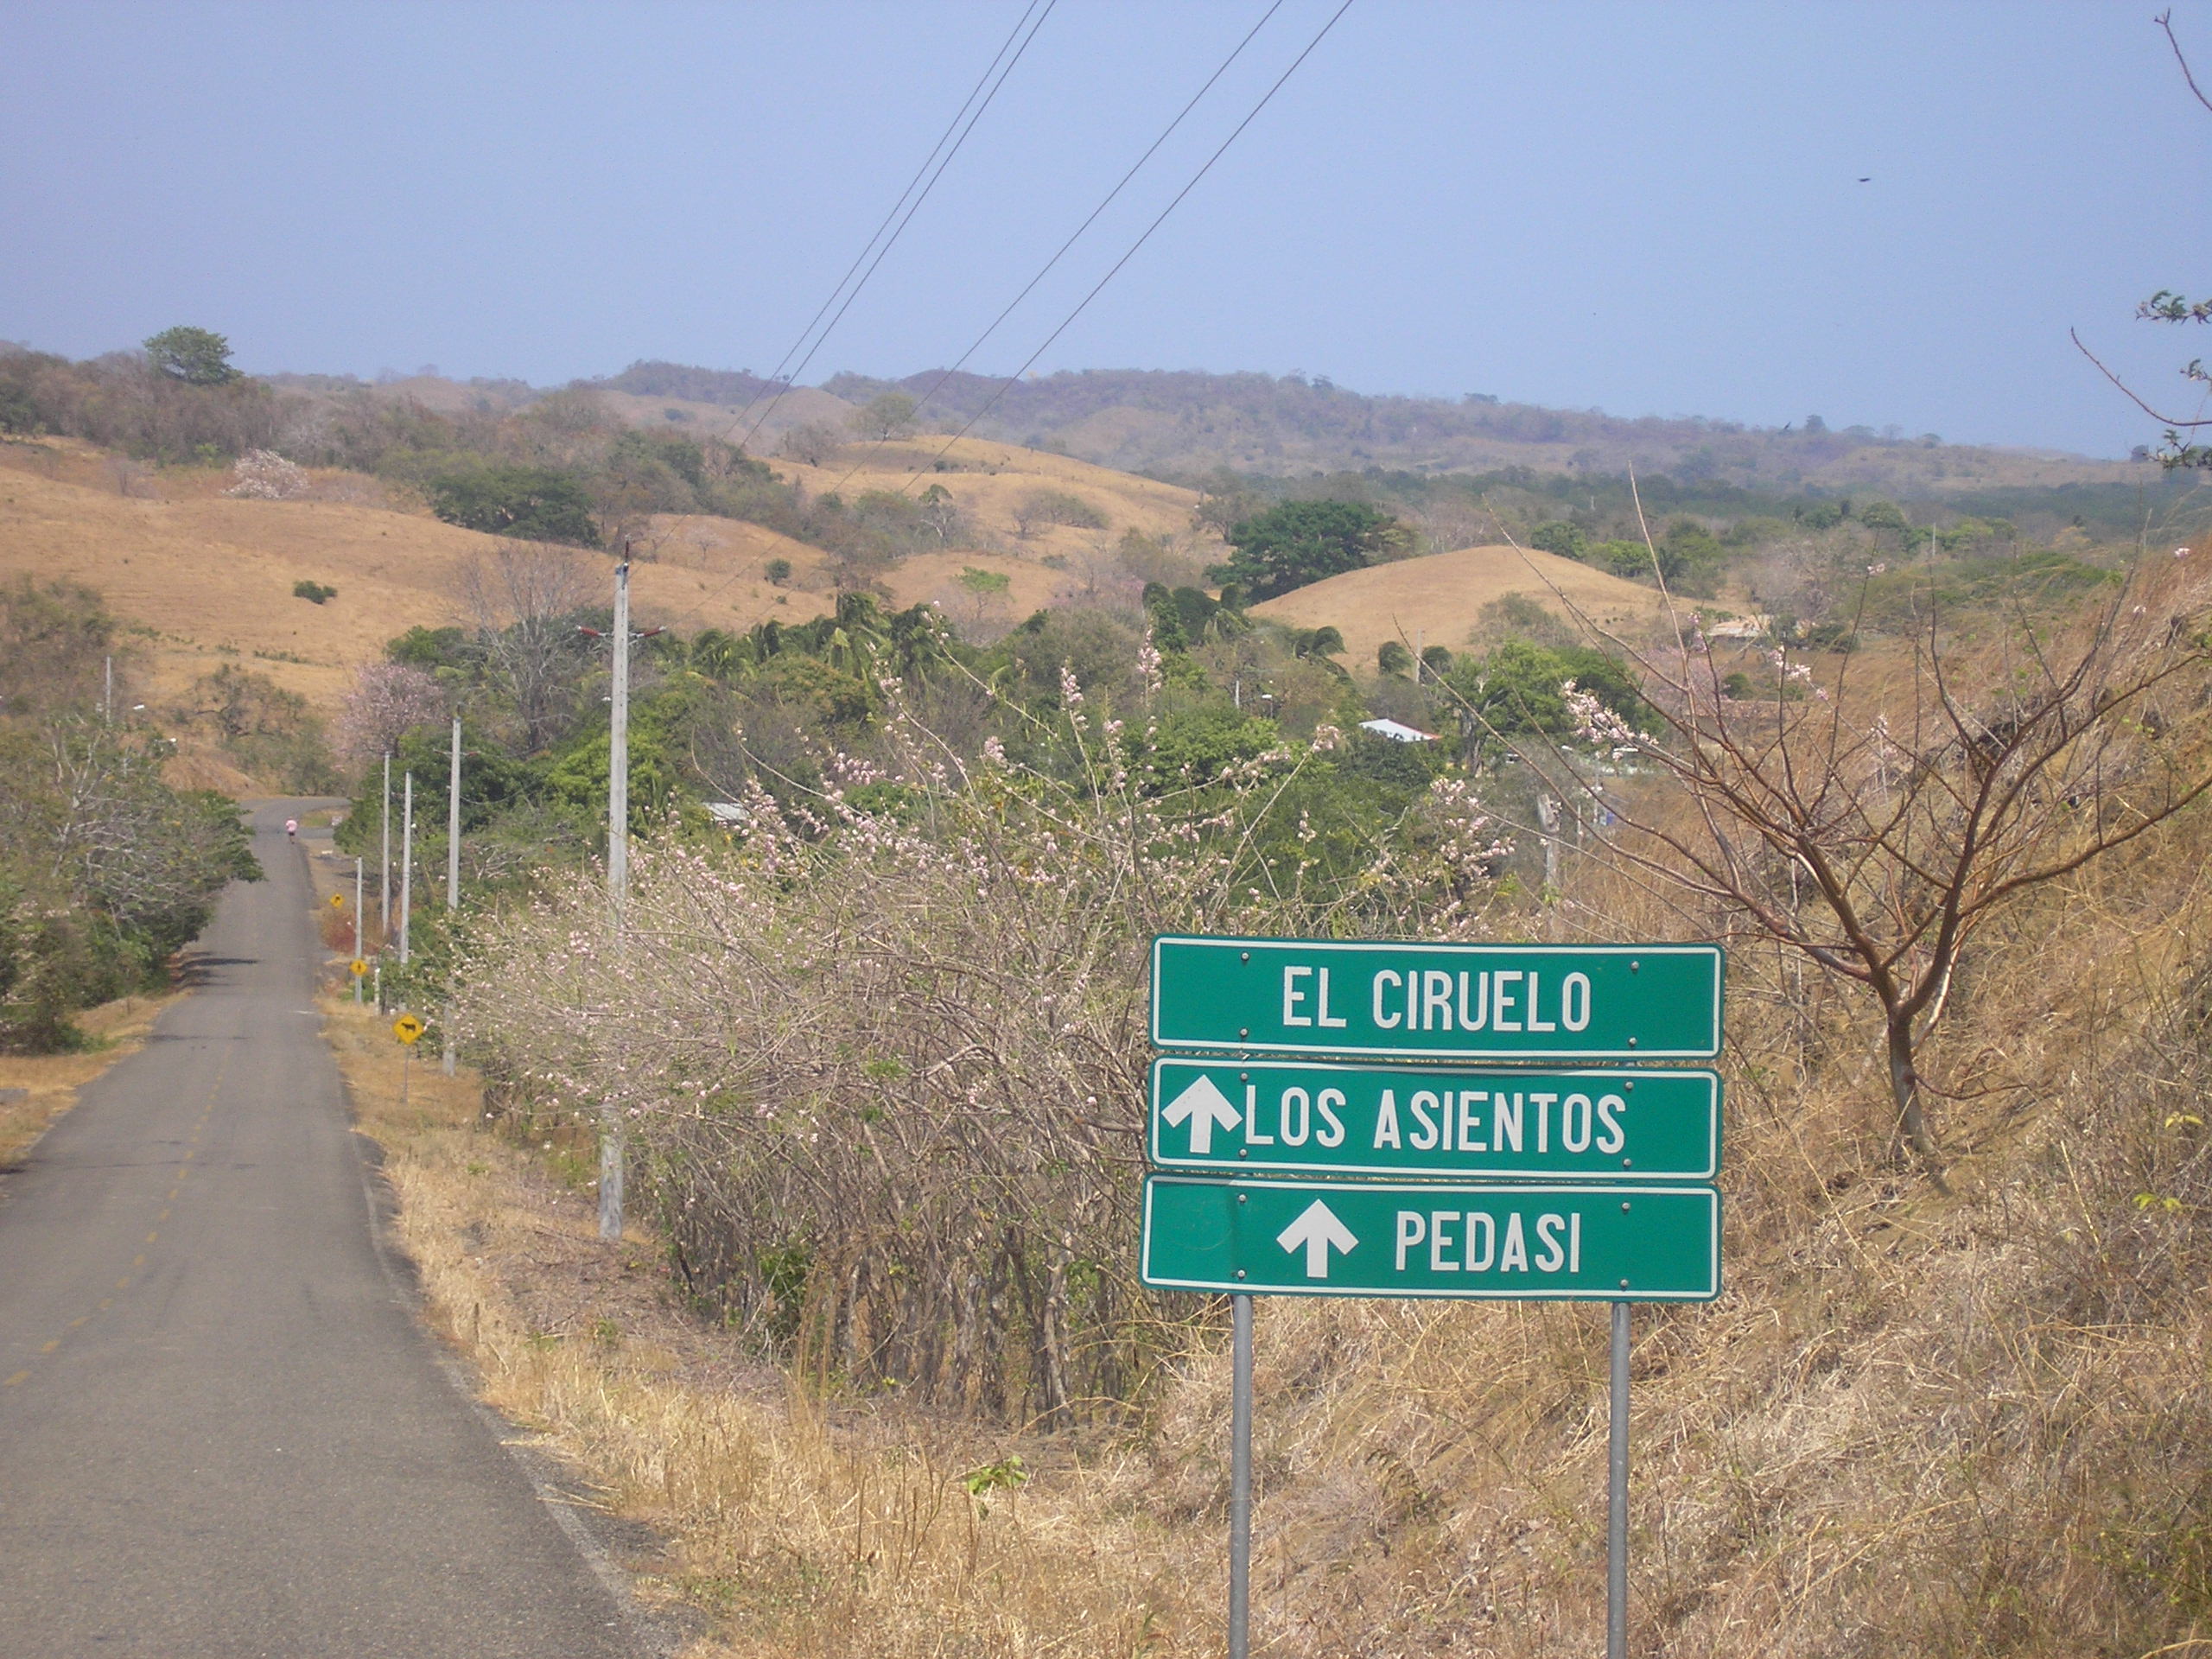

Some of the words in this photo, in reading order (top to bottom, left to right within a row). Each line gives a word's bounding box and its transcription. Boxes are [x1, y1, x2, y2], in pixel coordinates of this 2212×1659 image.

[1283, 965, 1347, 1028] EL
[1373, 969, 1591, 1032] CIRUELO
[1245, 1084, 1346, 1148] LOS
[1373, 1089, 1626, 1154] ASIENTOS
[1395, 1211, 1580, 1273] PEDASI
